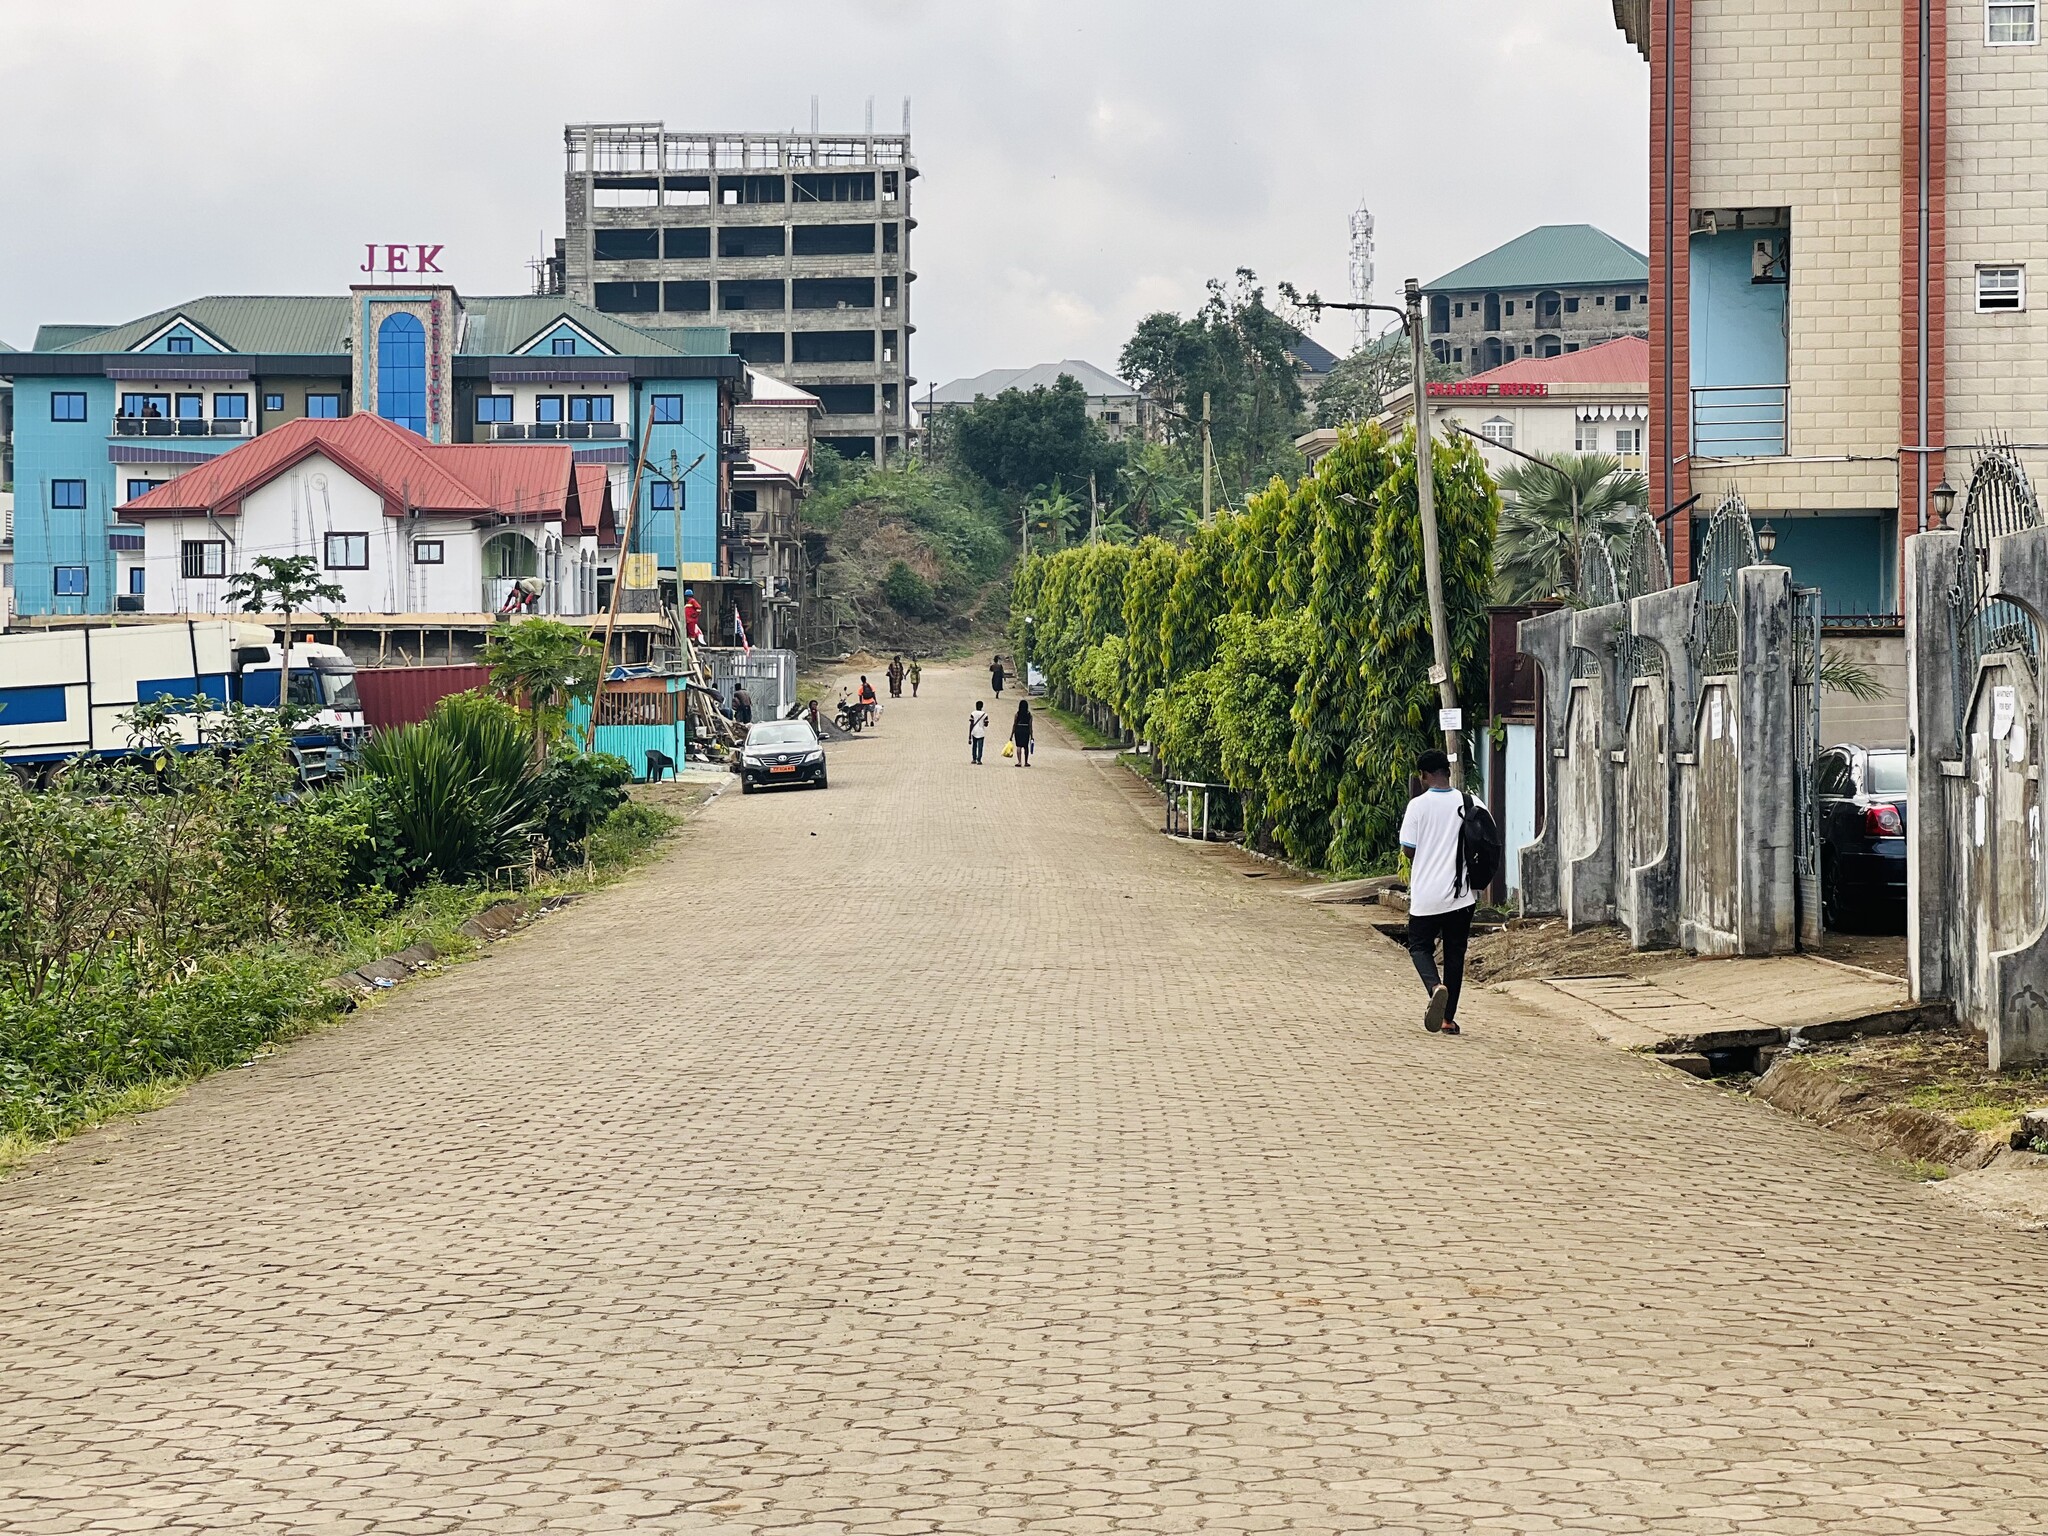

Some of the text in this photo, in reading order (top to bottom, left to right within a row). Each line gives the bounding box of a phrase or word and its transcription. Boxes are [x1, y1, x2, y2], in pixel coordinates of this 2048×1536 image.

[360, 244, 445, 273] JEK
[428, 300, 441, 423] RESIDENCE
[1426, 382, 1548, 396] CHARIOT HOTEL
